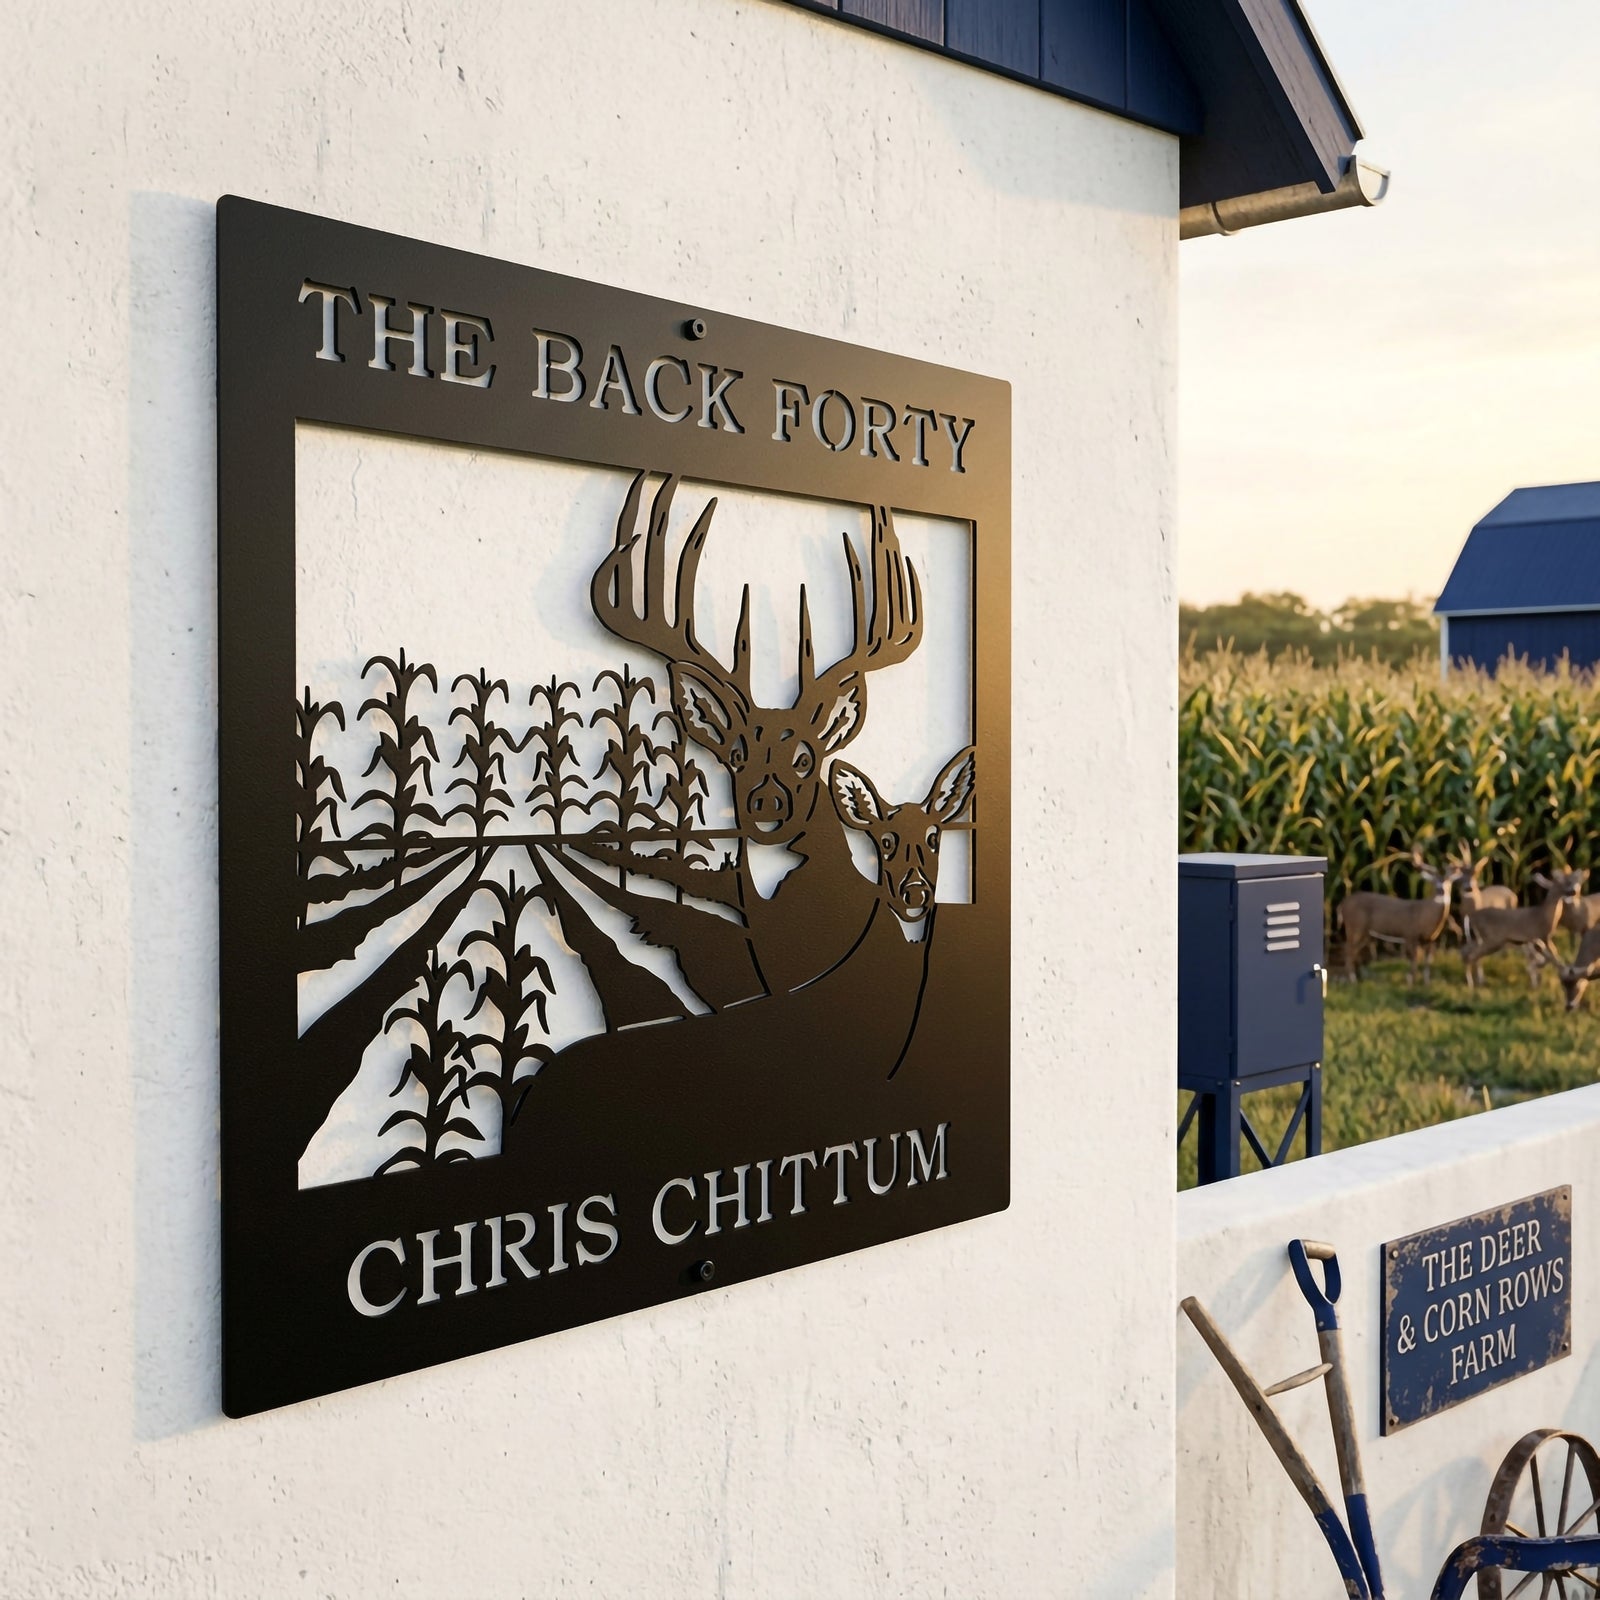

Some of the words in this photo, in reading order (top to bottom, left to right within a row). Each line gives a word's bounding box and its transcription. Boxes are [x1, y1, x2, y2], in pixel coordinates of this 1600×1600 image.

[298, 278, 497, 389] THE
[532, 327, 745, 434] BACK
[771, 378, 976, 473] FORTY
[347, 1193, 619, 1318] CHRIS
[652, 1121, 951, 1246] CHITTUM
[1422, 1240, 1473, 1292] THE
[1480, 1218, 1542, 1273] DEER
[1397, 1314, 1417, 1354] &
[1423, 1284, 1491, 1343] CORN
[1498, 1257, 1564, 1316] ROWS
[1450, 1323, 1516, 1386] FARM
